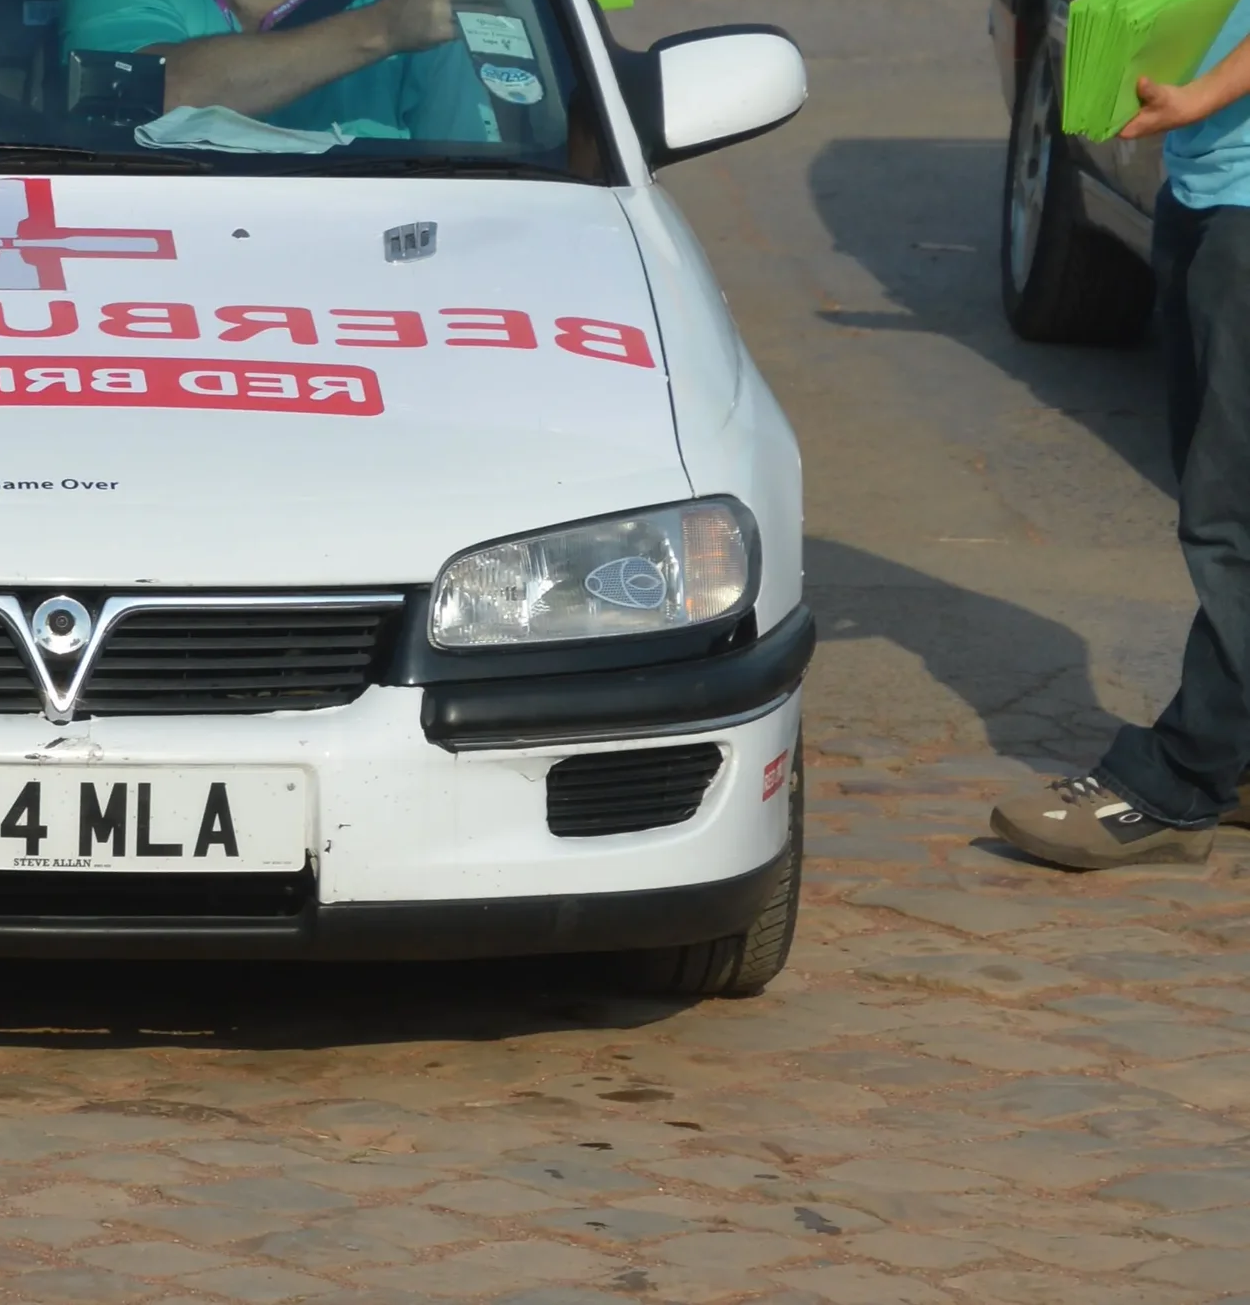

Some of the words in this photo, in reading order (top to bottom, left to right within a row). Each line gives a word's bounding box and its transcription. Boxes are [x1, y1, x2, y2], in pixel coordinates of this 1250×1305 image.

[61, 478, 119, 491] Over
[78, 781, 240, 858] MLA
[13, 857, 50, 867] STEVE
[52, 858, 92, 868] ALLAN
